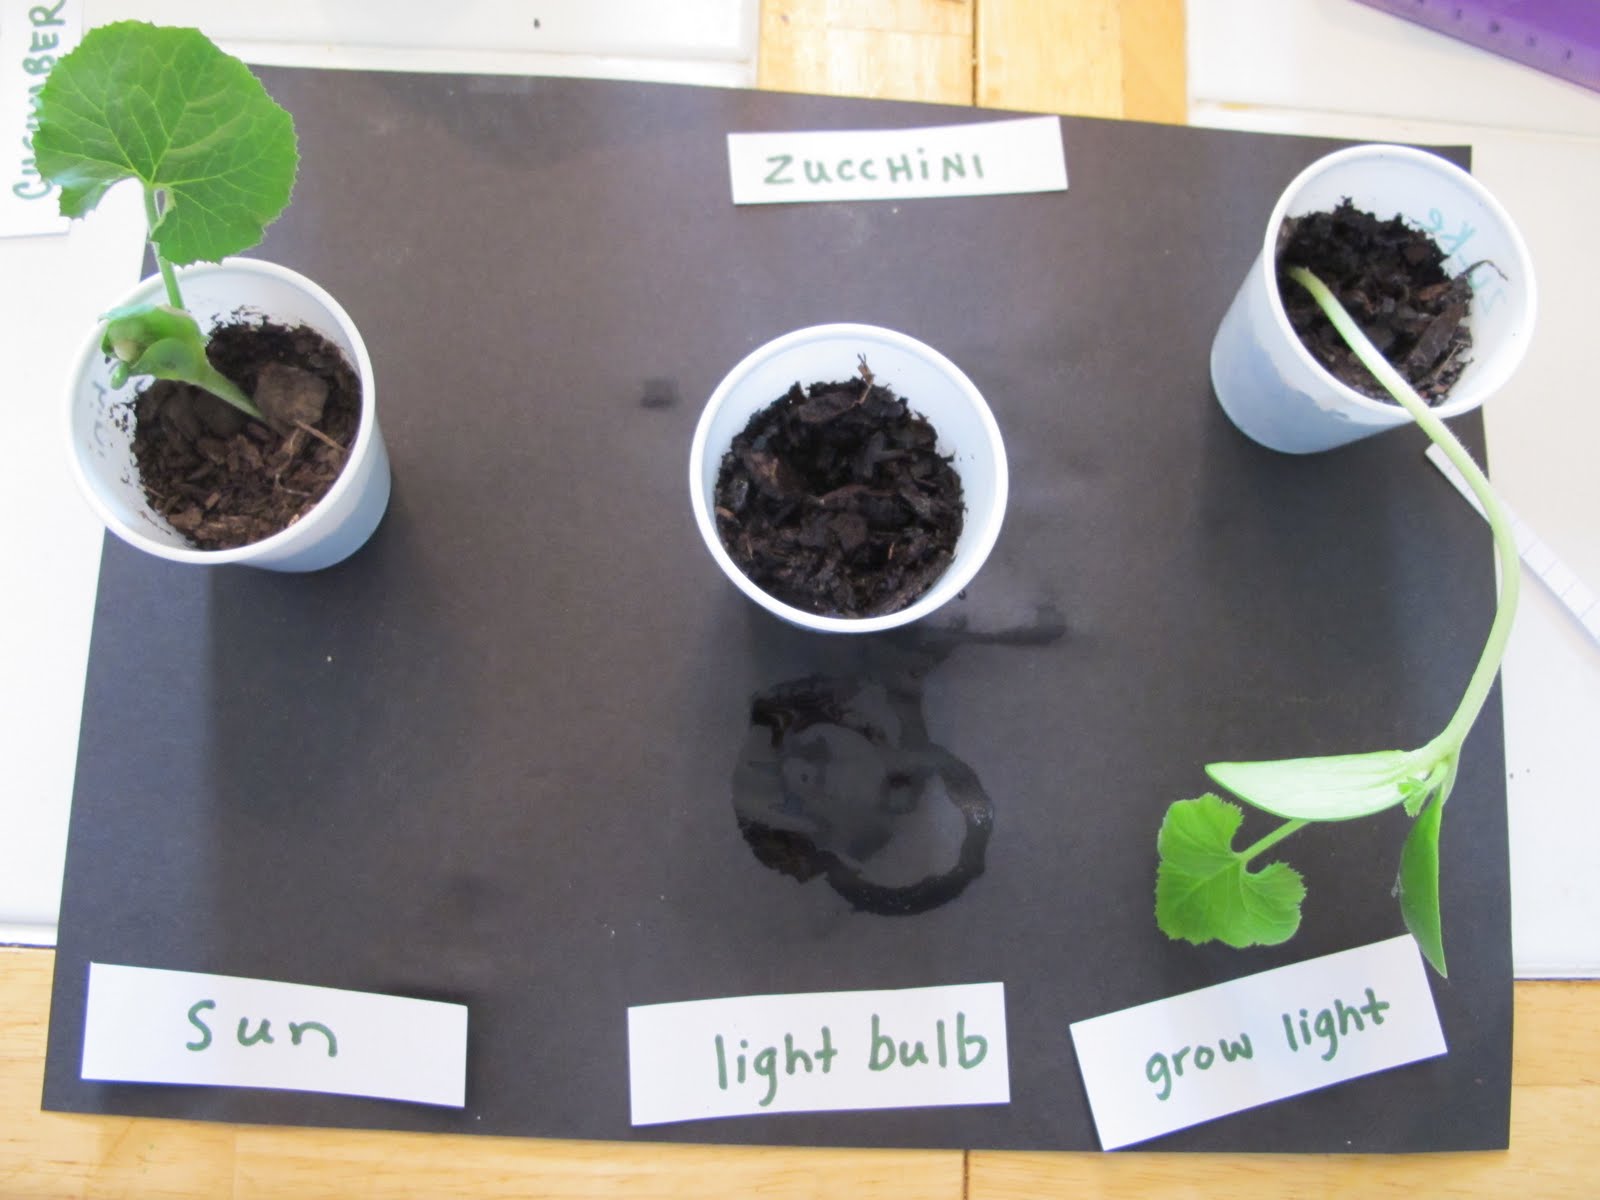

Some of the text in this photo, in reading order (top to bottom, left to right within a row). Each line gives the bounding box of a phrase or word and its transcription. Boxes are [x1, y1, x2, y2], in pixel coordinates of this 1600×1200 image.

[186, 1000, 338, 1058] Sun
[715, 1012, 988, 1107] light bulb
[1145, 987, 1390, 1101] grow light
